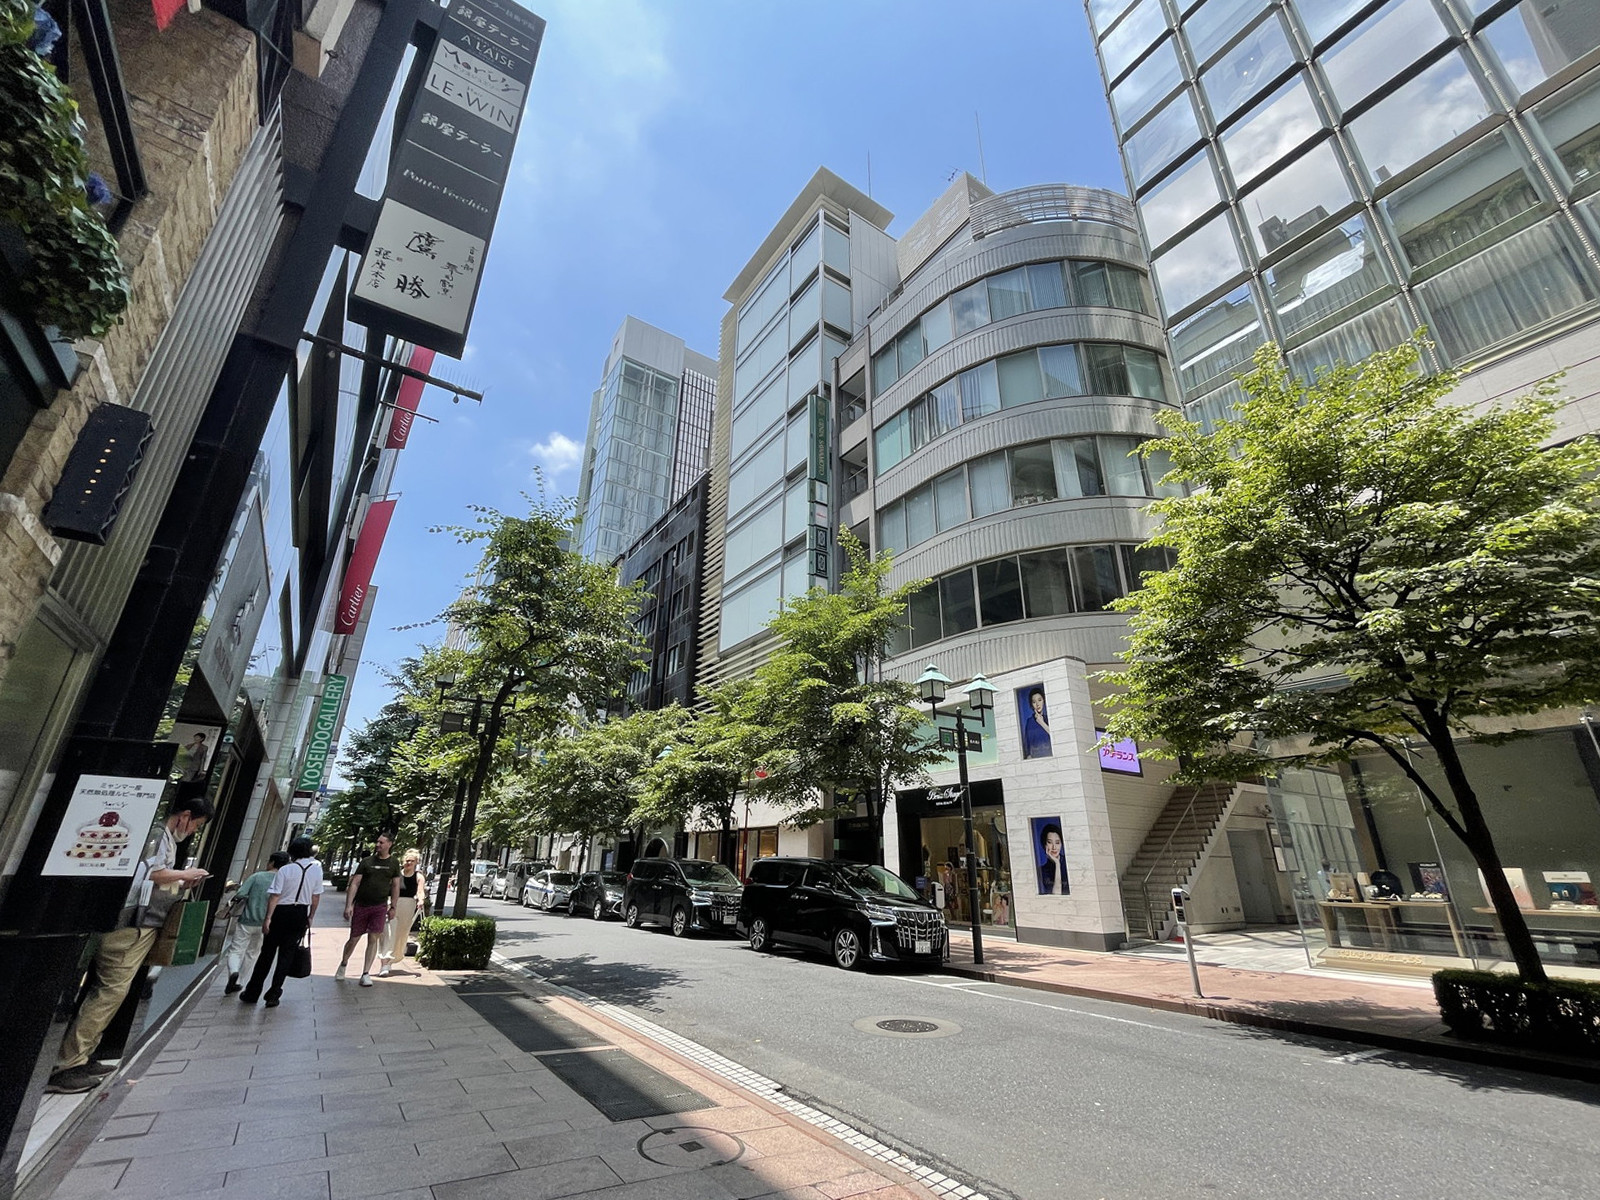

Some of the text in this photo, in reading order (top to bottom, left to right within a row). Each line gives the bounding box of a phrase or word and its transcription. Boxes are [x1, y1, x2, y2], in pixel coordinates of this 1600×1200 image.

[457, 5, 530, 51] 銀座テーラー
[460, 34, 472, 46] A
[476, 41, 516, 70] L'AISE
[421, 112, 503, 159] 銀座テーラー
[340, 584, 363, 627] Cartier
